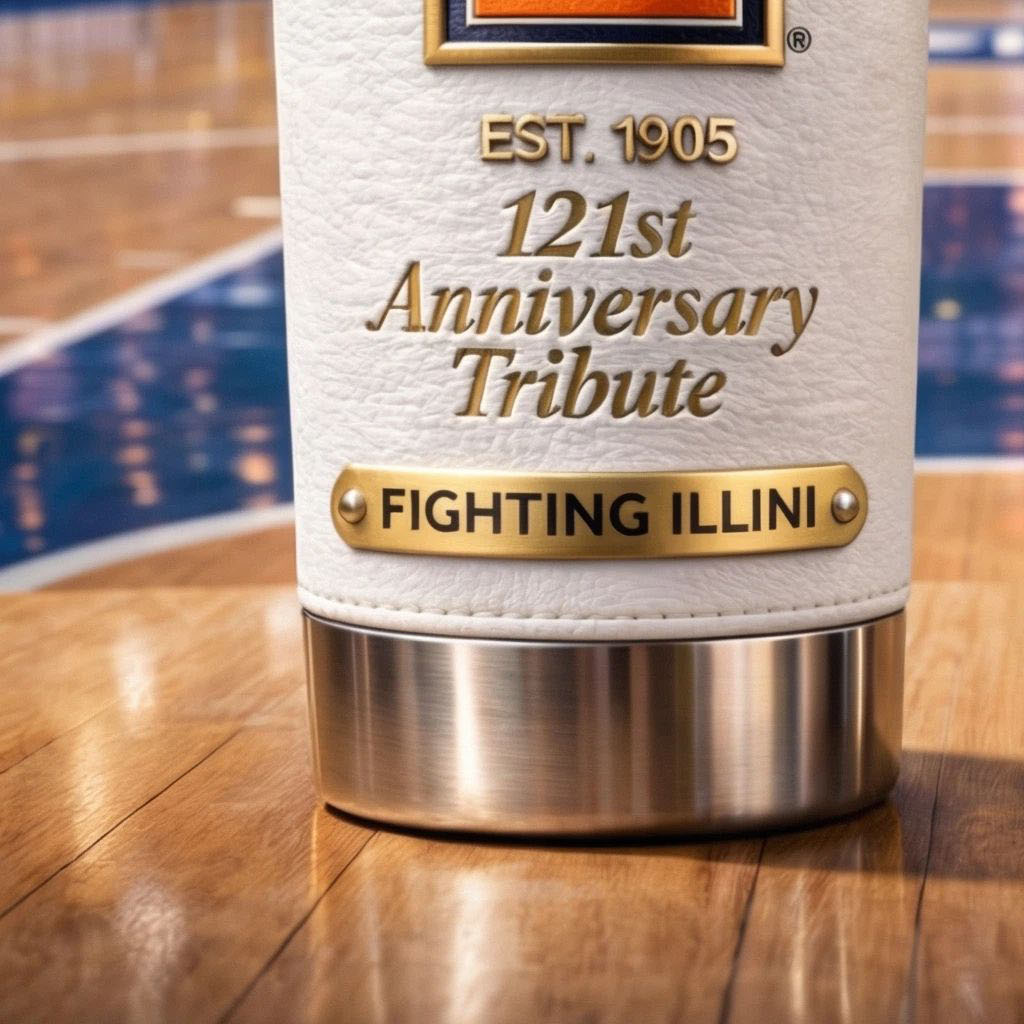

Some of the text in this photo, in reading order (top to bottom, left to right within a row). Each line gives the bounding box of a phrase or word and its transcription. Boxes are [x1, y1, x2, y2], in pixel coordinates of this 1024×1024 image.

[479, 113, 738, 163] EST. 1905
[496, 189, 698, 258] 121st
[365, 260, 820, 357] Anniversary
[452, 345, 727, 419] Tribute
[380, 484, 816, 537] FIGHTING ILLINI
